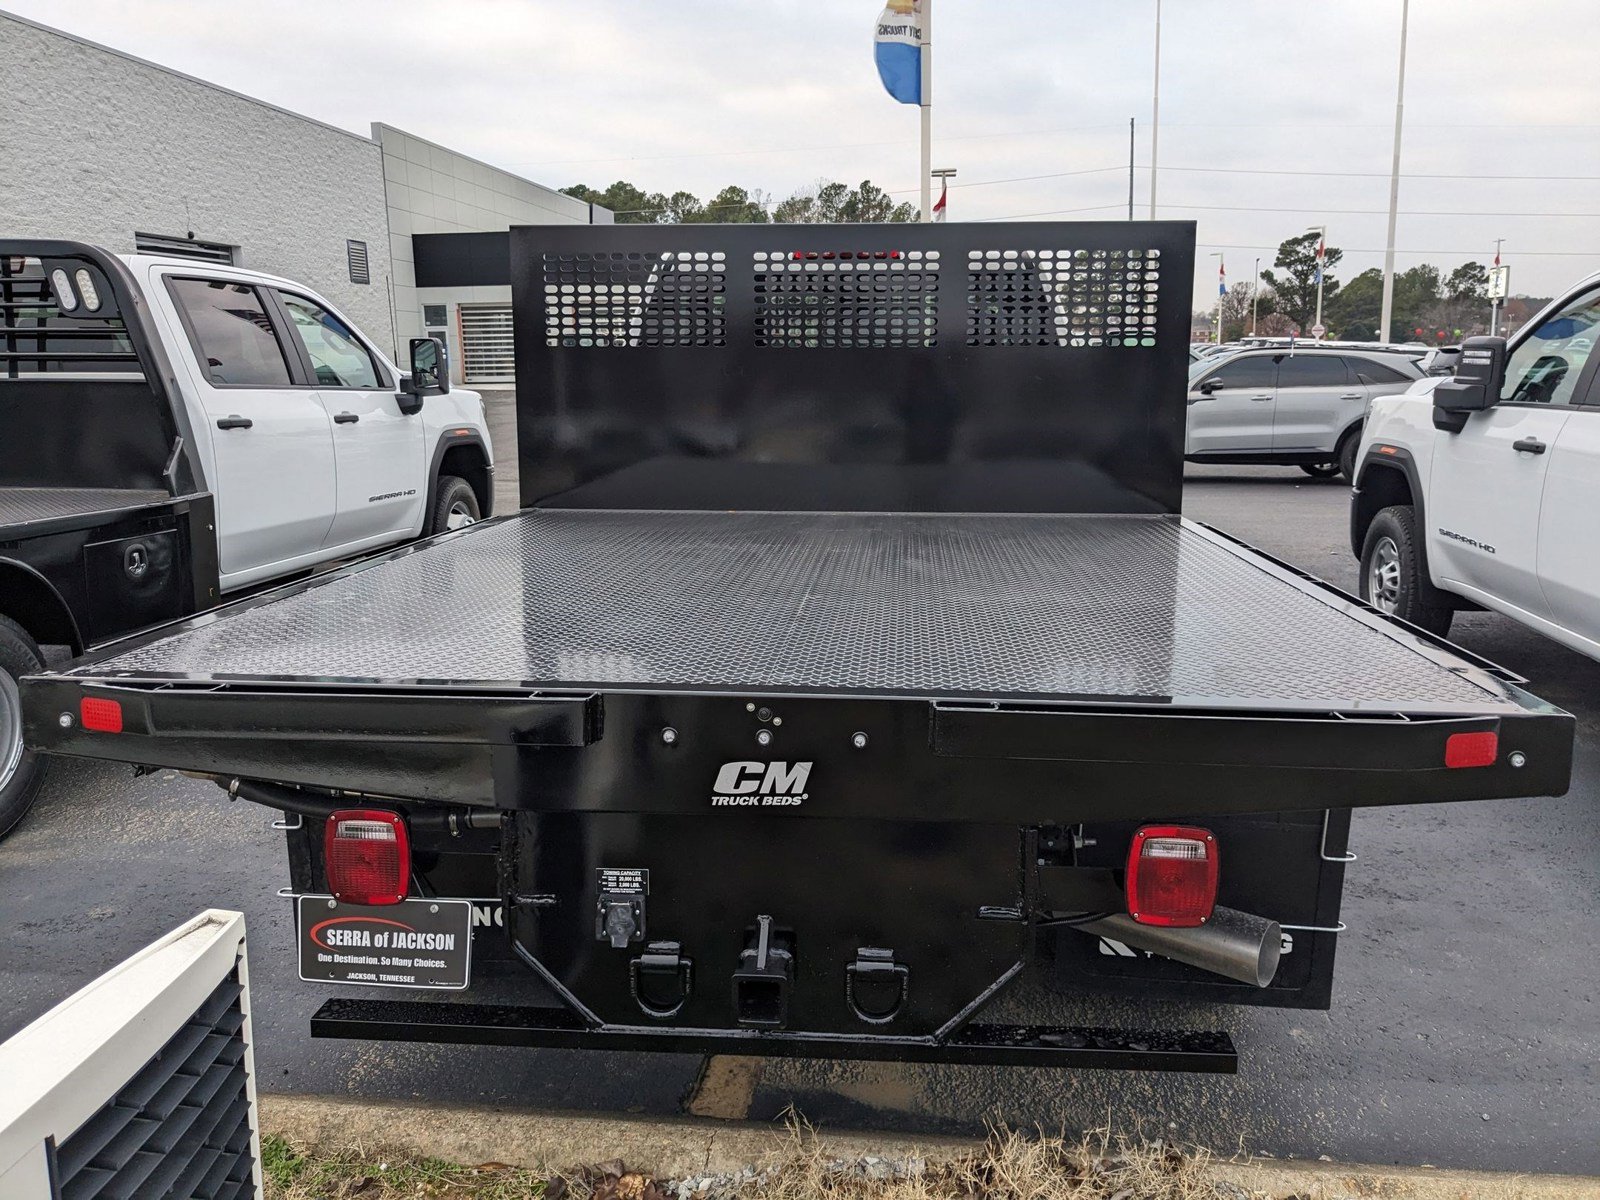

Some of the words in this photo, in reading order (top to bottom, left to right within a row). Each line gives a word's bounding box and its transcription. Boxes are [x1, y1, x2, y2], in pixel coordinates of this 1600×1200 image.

[368, 491, 402, 502] SIERRA
[1438, 528, 1477, 547] SIERRA
[1478, 542, 1496, 554] HD
[713, 761, 813, 794] CM
[711, 796, 760, 806] TRUCK
[326, 929, 371, 947] SERRA
[374, 931, 389, 948] of
[391, 932, 455, 951] JACKSON
[318, 953, 333, 963] One
[334, 954, 380, 965] Destination.
[381, 956, 390, 966] So
[392, 957, 412, 967] Many
[413, 957, 447, 968] Choices.
[346, 972, 378, 982] JACKSON,
[379, 974, 415, 983] TENNESSEE
